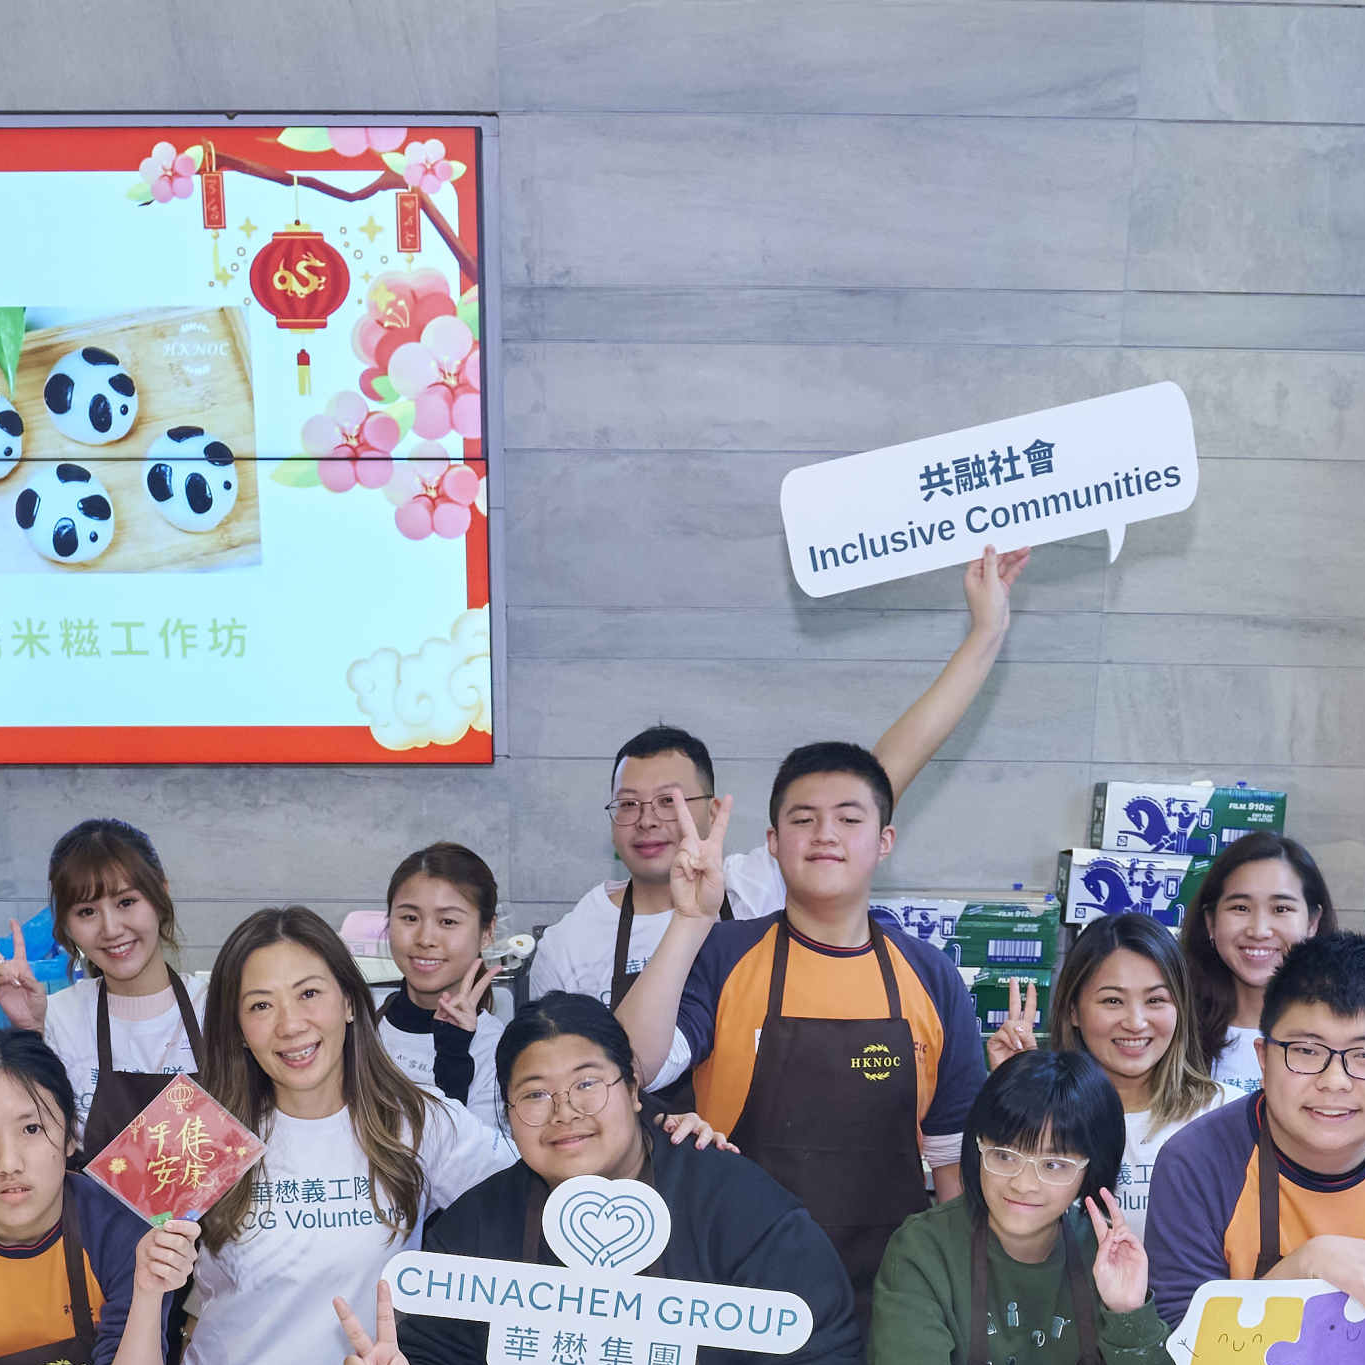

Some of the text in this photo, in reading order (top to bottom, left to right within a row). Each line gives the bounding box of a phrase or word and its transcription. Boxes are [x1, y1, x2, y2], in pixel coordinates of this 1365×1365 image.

[919, 438, 1056, 502] 共融社會
[808, 464, 1182, 572] Inclusive Communities
[851, 1056, 901, 1068] HKNOC
[396, 1266, 798, 1337] CHINACHEM GROUP
